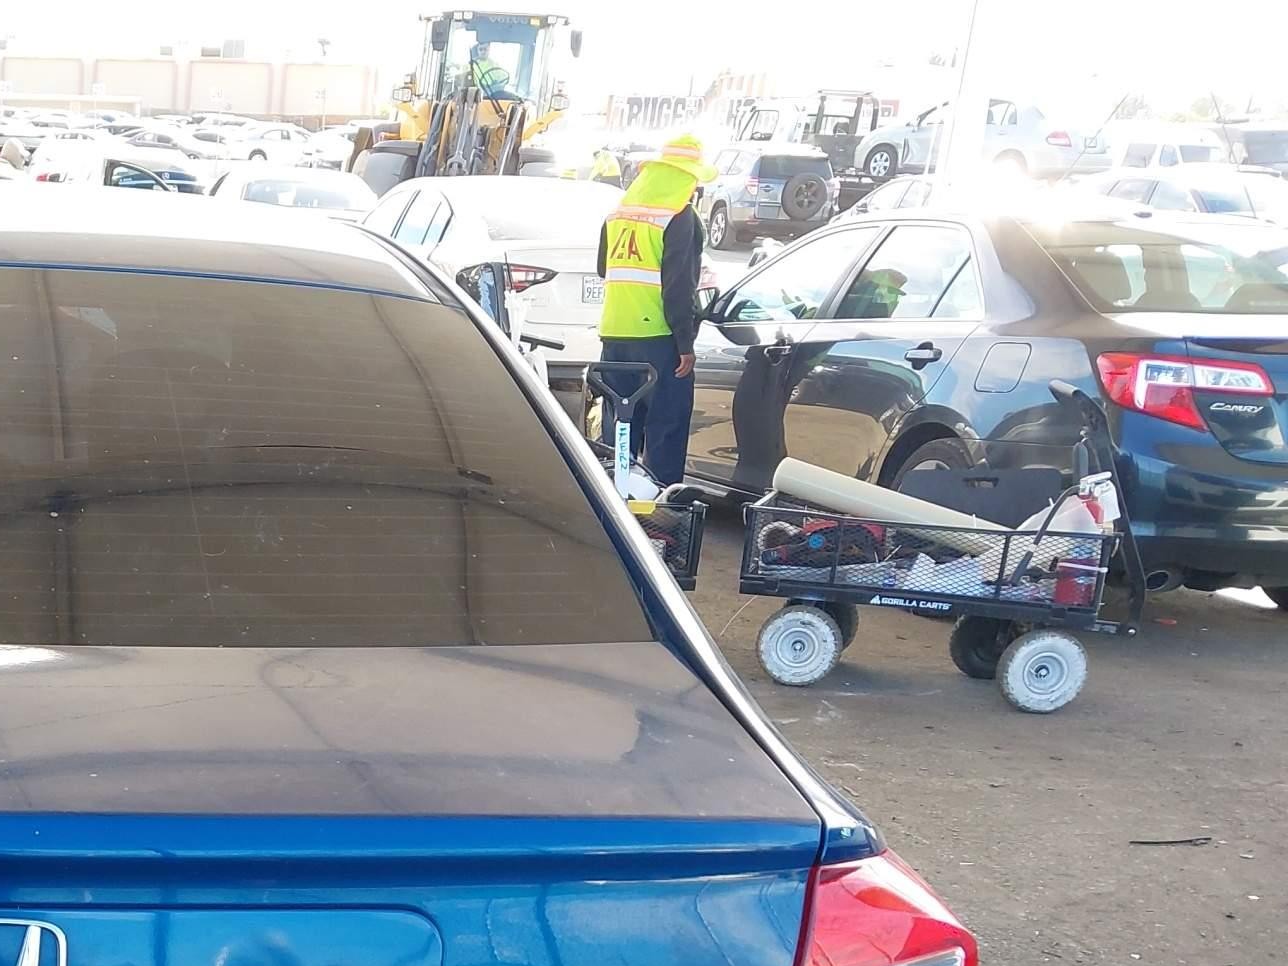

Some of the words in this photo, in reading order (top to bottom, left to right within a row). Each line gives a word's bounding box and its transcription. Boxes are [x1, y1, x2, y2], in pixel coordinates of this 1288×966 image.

[489, 16, 529, 25] VOLVO
[586, 286, 606, 299] 9EF
[1210, 402, 1264, 413] CAMRY
[881, 597, 917, 607] GORILLA
[919, 601, 950, 610] CARTS
